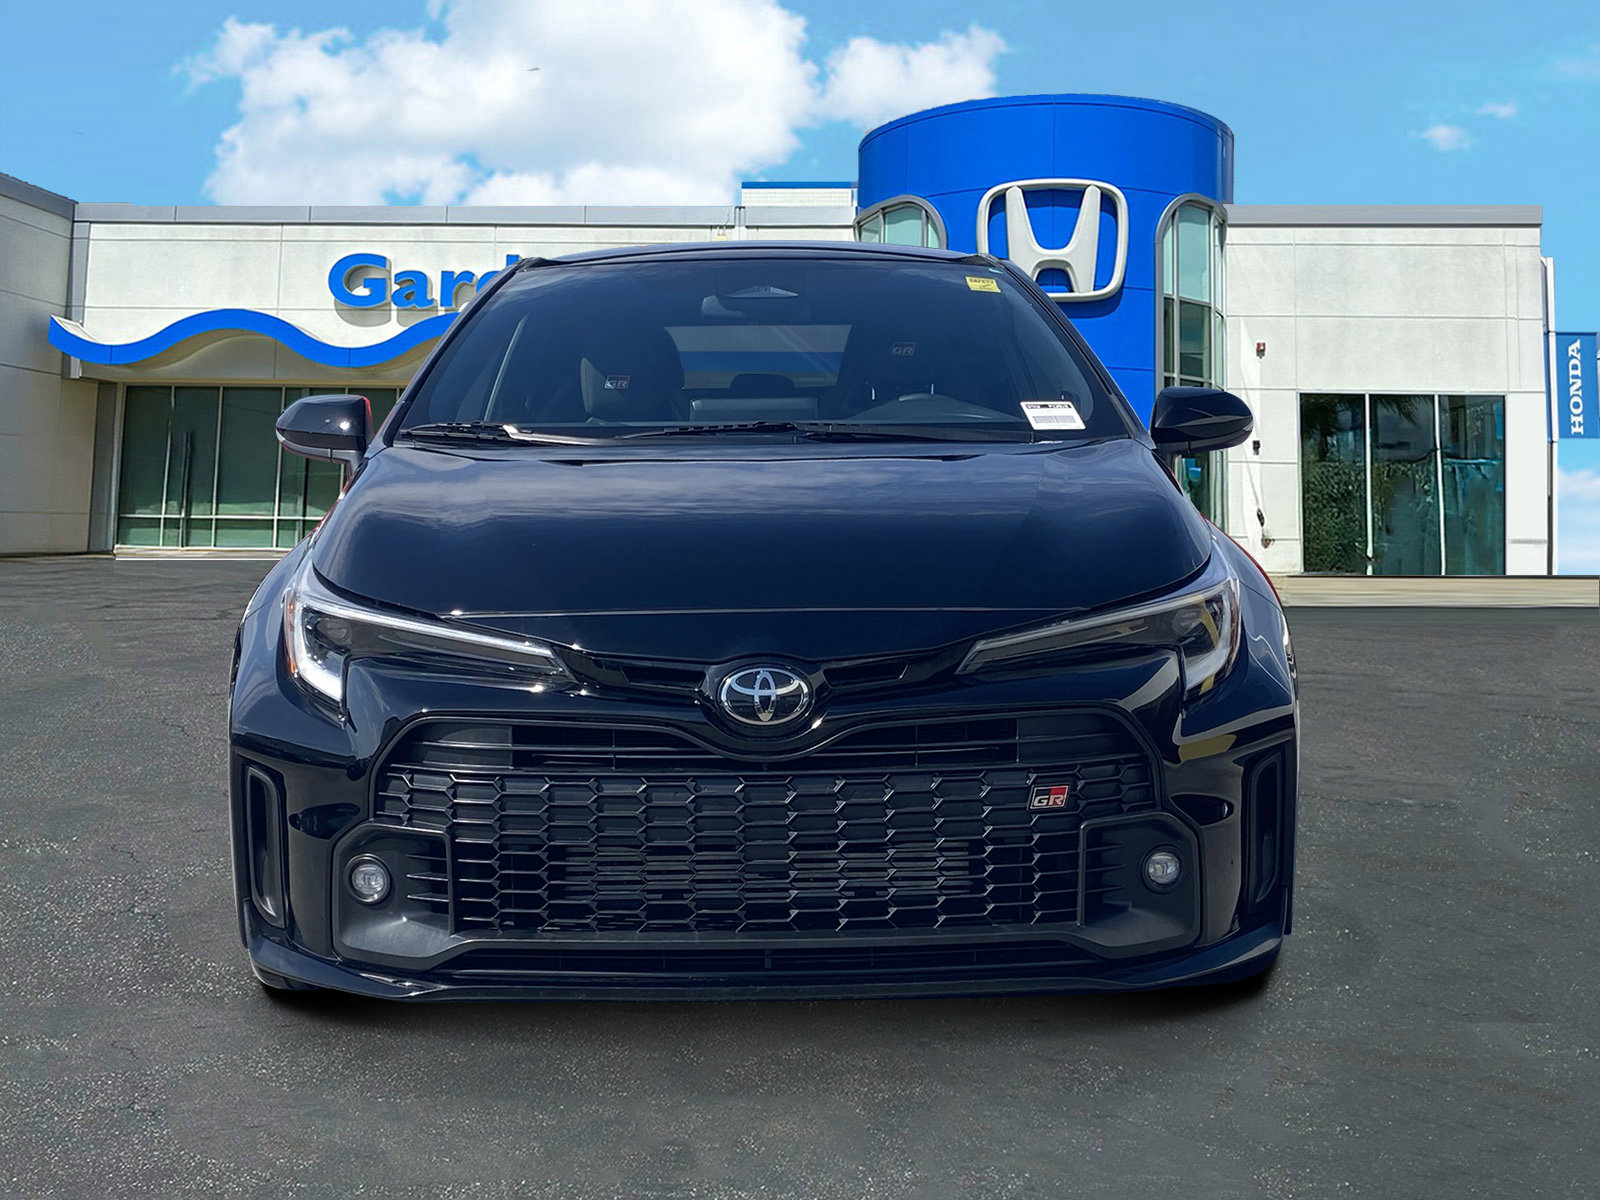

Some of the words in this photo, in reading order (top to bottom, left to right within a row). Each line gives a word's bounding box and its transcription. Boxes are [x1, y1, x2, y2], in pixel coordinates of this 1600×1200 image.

[328, 252, 520, 309] Gar
[1568, 339, 1584, 435] HONDA
[1033, 794, 1064, 806] GR
